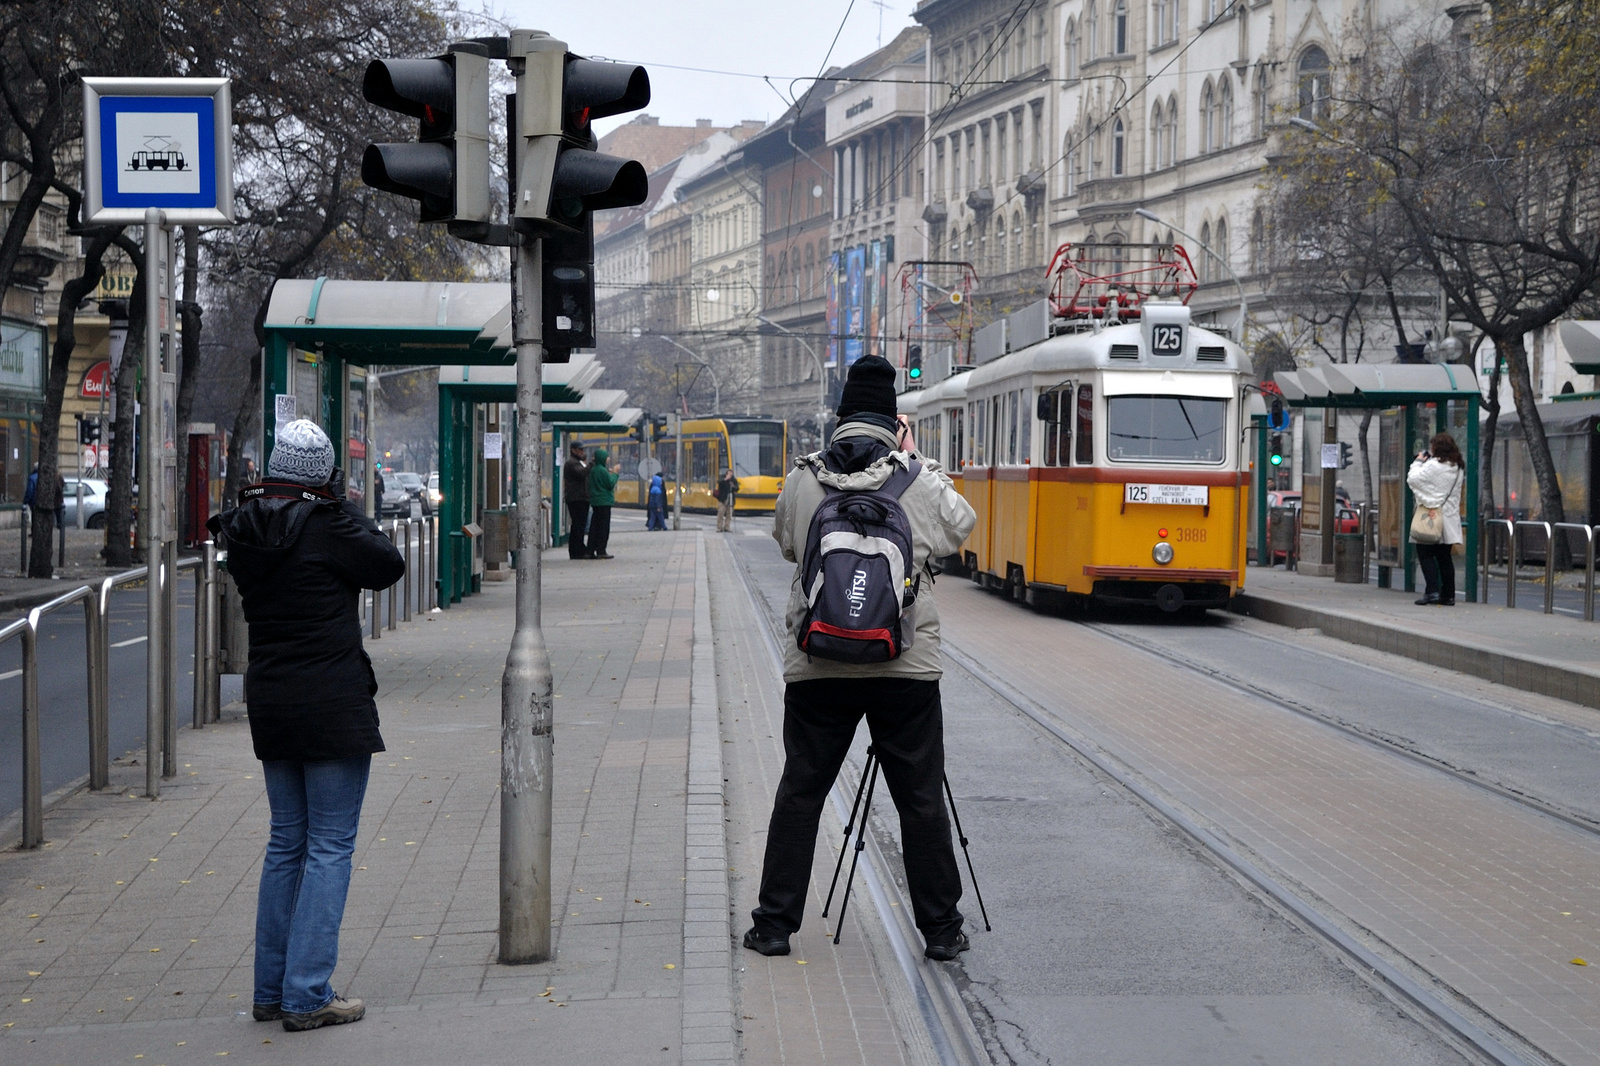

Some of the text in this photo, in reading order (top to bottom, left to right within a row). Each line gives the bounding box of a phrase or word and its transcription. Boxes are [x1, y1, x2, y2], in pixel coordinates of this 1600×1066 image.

[102, 276, 136, 291] OB
[1154, 327, 1180, 349] 125
[244, 488, 264, 497] Canon
[1129, 486, 1147, 501] 125
[1176, 527, 1207, 542] 3888
[847, 569, 867, 617] FUJITSU
